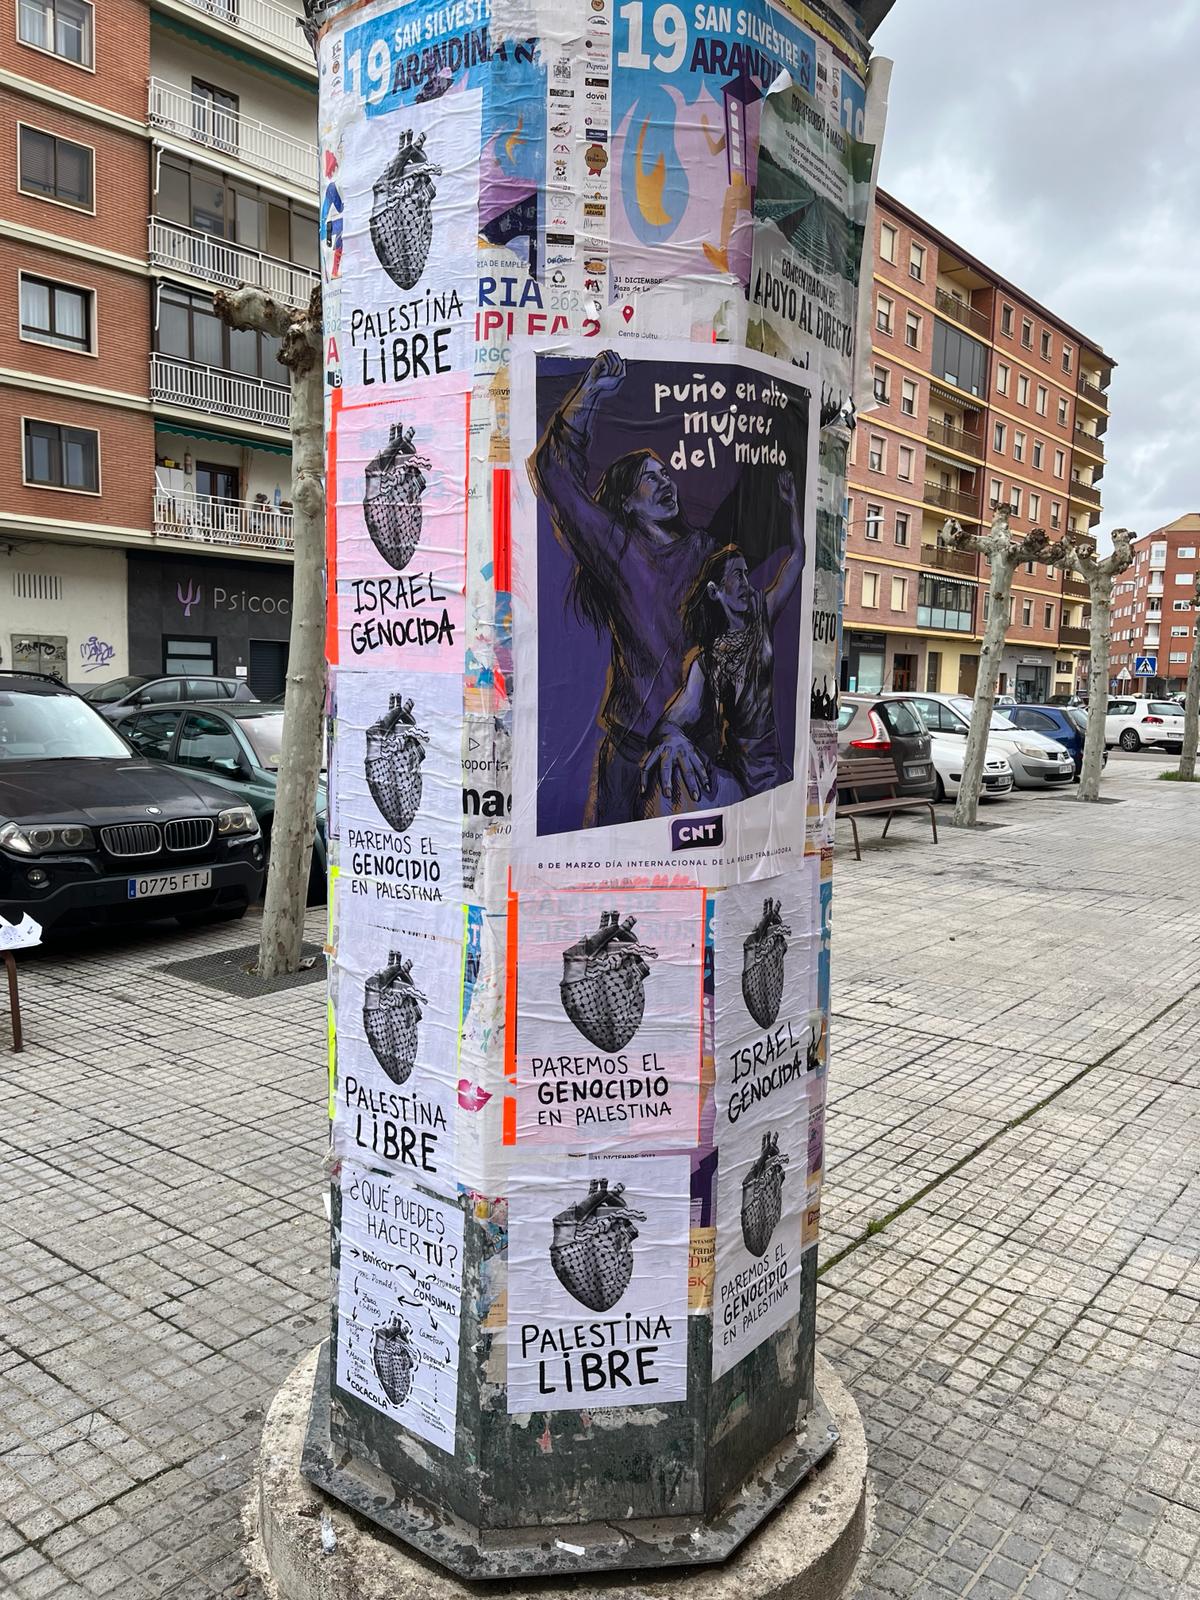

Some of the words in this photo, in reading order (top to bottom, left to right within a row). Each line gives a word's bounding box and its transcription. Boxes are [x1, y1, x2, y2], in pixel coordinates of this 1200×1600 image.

[394, 19, 421, 52] SAN
[617, 1, 687, 73] 19
[694, 4, 732, 33] SAN
[737, 9, 799, 69] SILVESTRE
[348, 39, 391, 104] 19
[586, 92, 607, 100] dovel
[614, 284, 630, 292] Plaza
[754, 267, 797, 322] APOYO
[798, 295, 813, 335] AL
[655, 373, 727, 412] puño
[736, 380, 756, 401] en
[761, 380, 789, 409] alto
[684, 404, 772, 446] mujeres
[670, 436, 716, 471] del
[735, 440, 787, 466] mundo
[352, 572, 446, 615] ISRAEL
[351, 609, 455, 655] GENOCIDA
[348, 829, 412, 855] PAREMOS
[421, 837, 438, 855] EL
[678, 824, 716, 843] CNT
[140, 876, 177, 894] 0775
[183, 872, 209, 889] FTJ
[352, 853, 441, 882] GENOCIDIO
[565, 861, 601, 869] MARZO
[605, 860, 623, 868] DÍA
[352, 880, 368, 895] EN
[376, 882, 442, 901] PALESTINA
[532, 1055, 628, 1077] PAREMOS
[643, 1053, 665, 1071] EL
[730, 1022, 800, 1083] ISRAEL
[538, 1075, 669, 1104] GENOCIDIO
[728, 1056, 802, 1123] GENOCIDA
[538, 1111, 562, 1126] EN
[576, 1102, 672, 1125] PALESTINA
[350, 1171, 391, 1213] ¿QUÉ
[394, 1195, 445, 1236] PUEDES
[367, 1213, 421, 1255] HACER
[417, 1279, 431, 1291] NO
[721, 1254, 769, 1303] PAREMOS
[775, 1243, 786, 1263] EL
[414, 1288, 456, 1315] CONSUMAS
[723, 1262, 788, 1326] GENOCIDIO
[723, 1329, 737, 1346] EN
[742, 1283, 789, 1333] PALESTINA
